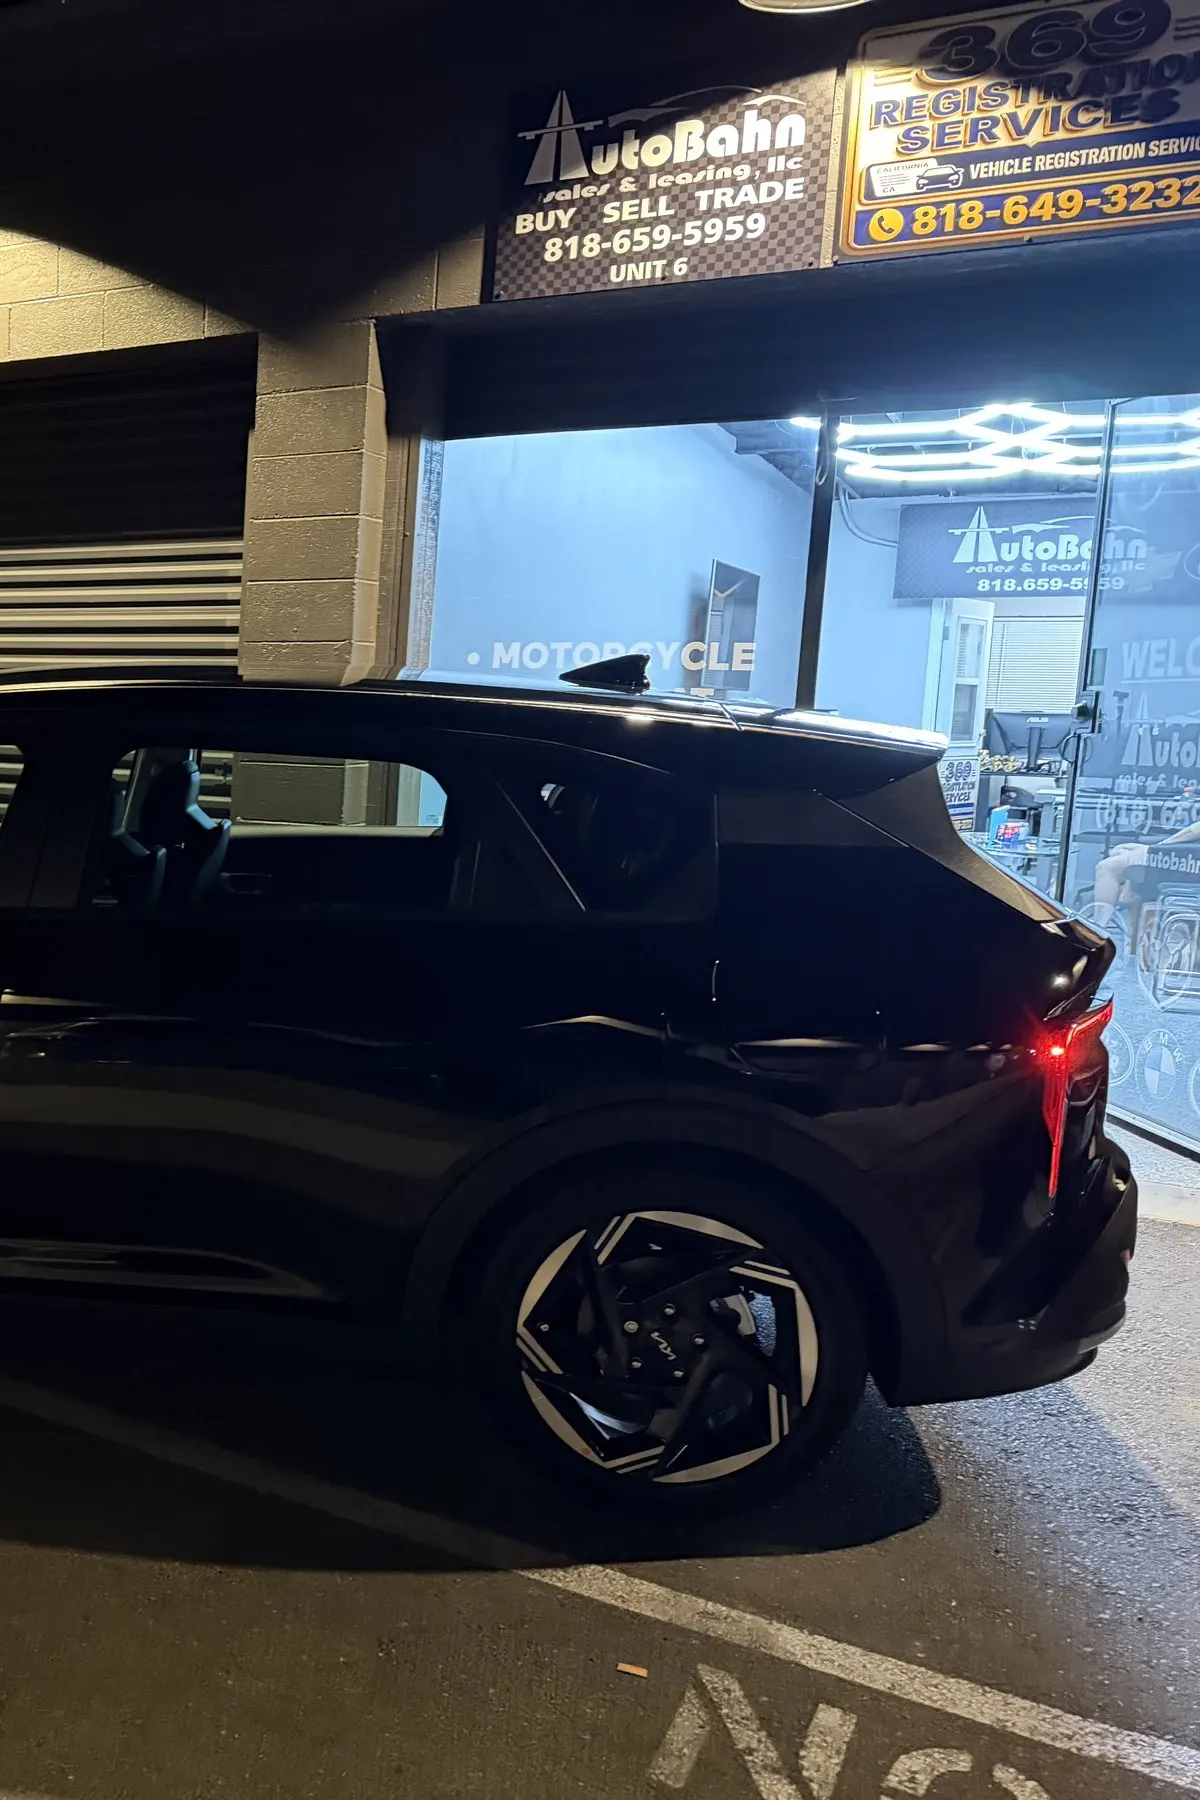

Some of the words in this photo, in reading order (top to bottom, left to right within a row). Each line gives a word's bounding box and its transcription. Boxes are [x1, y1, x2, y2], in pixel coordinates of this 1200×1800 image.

[916, 0, 1172, 85] 369
[896, 88, 1181, 154] SERVICES
[542, 183, 611, 203] sales
[619, 177, 638, 193] &
[648, 163, 761, 190] leasing,
[767, 155, 804, 172] llc
[969, 159, 1032, 180] VEHICLE
[1034, 142, 1147, 173] REGISTRATION
[515, 207, 577, 235] BUY
[603, 196, 675, 224] SELL
[694, 177, 806, 212] TRADE
[911, 175, 1200, 236] 818-649-3232
[543, 212, 767, 262] 818-659-5959
[609, 259, 667, 283] UNIT
[673, 257, 689, 276] 6
[966, 563, 1015, 574] sales
[1020, 563, 1033, 573] &
[1041, 560, 1117, 576] leasig,
[1121, 690, 1200, 768] Auto
[1173, 774, 1200, 788] lea
